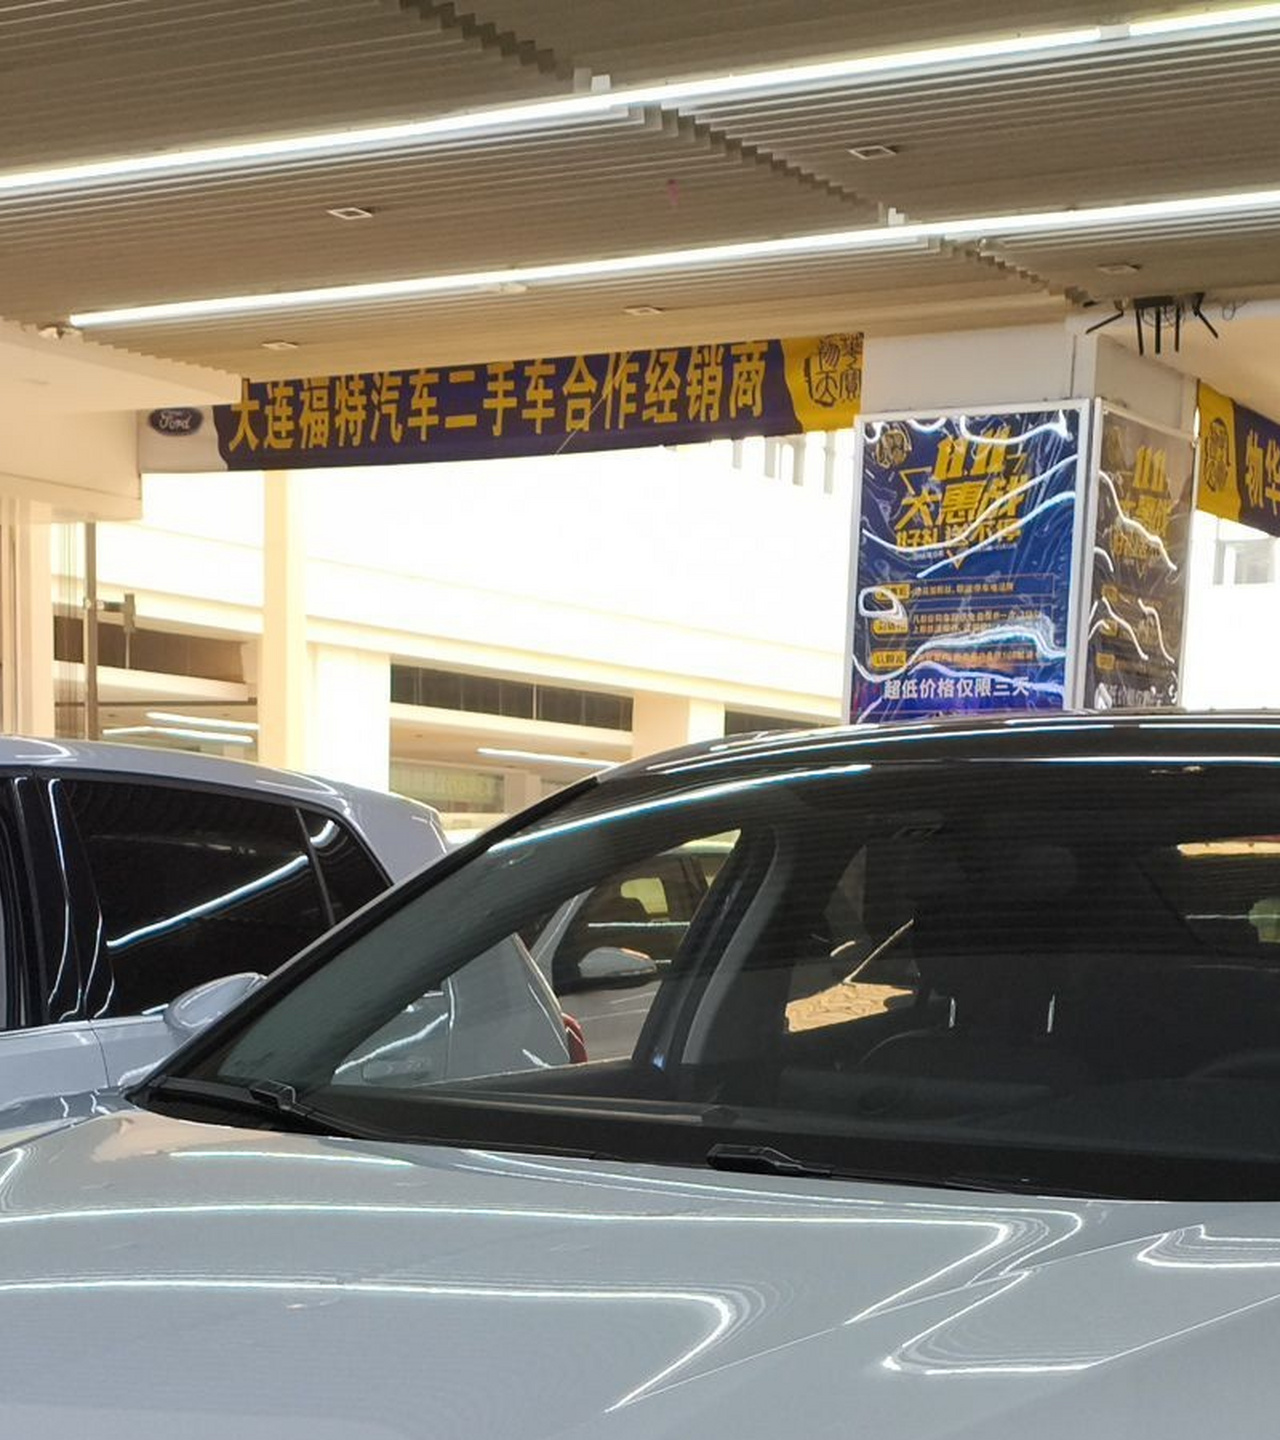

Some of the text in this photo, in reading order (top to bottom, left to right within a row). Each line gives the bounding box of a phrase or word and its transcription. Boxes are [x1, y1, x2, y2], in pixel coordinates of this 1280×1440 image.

[228, 340, 768, 454] 大连福特汽车二手车合作经销商
[883, 676, 1031, 701] 超低价格仅限三天
